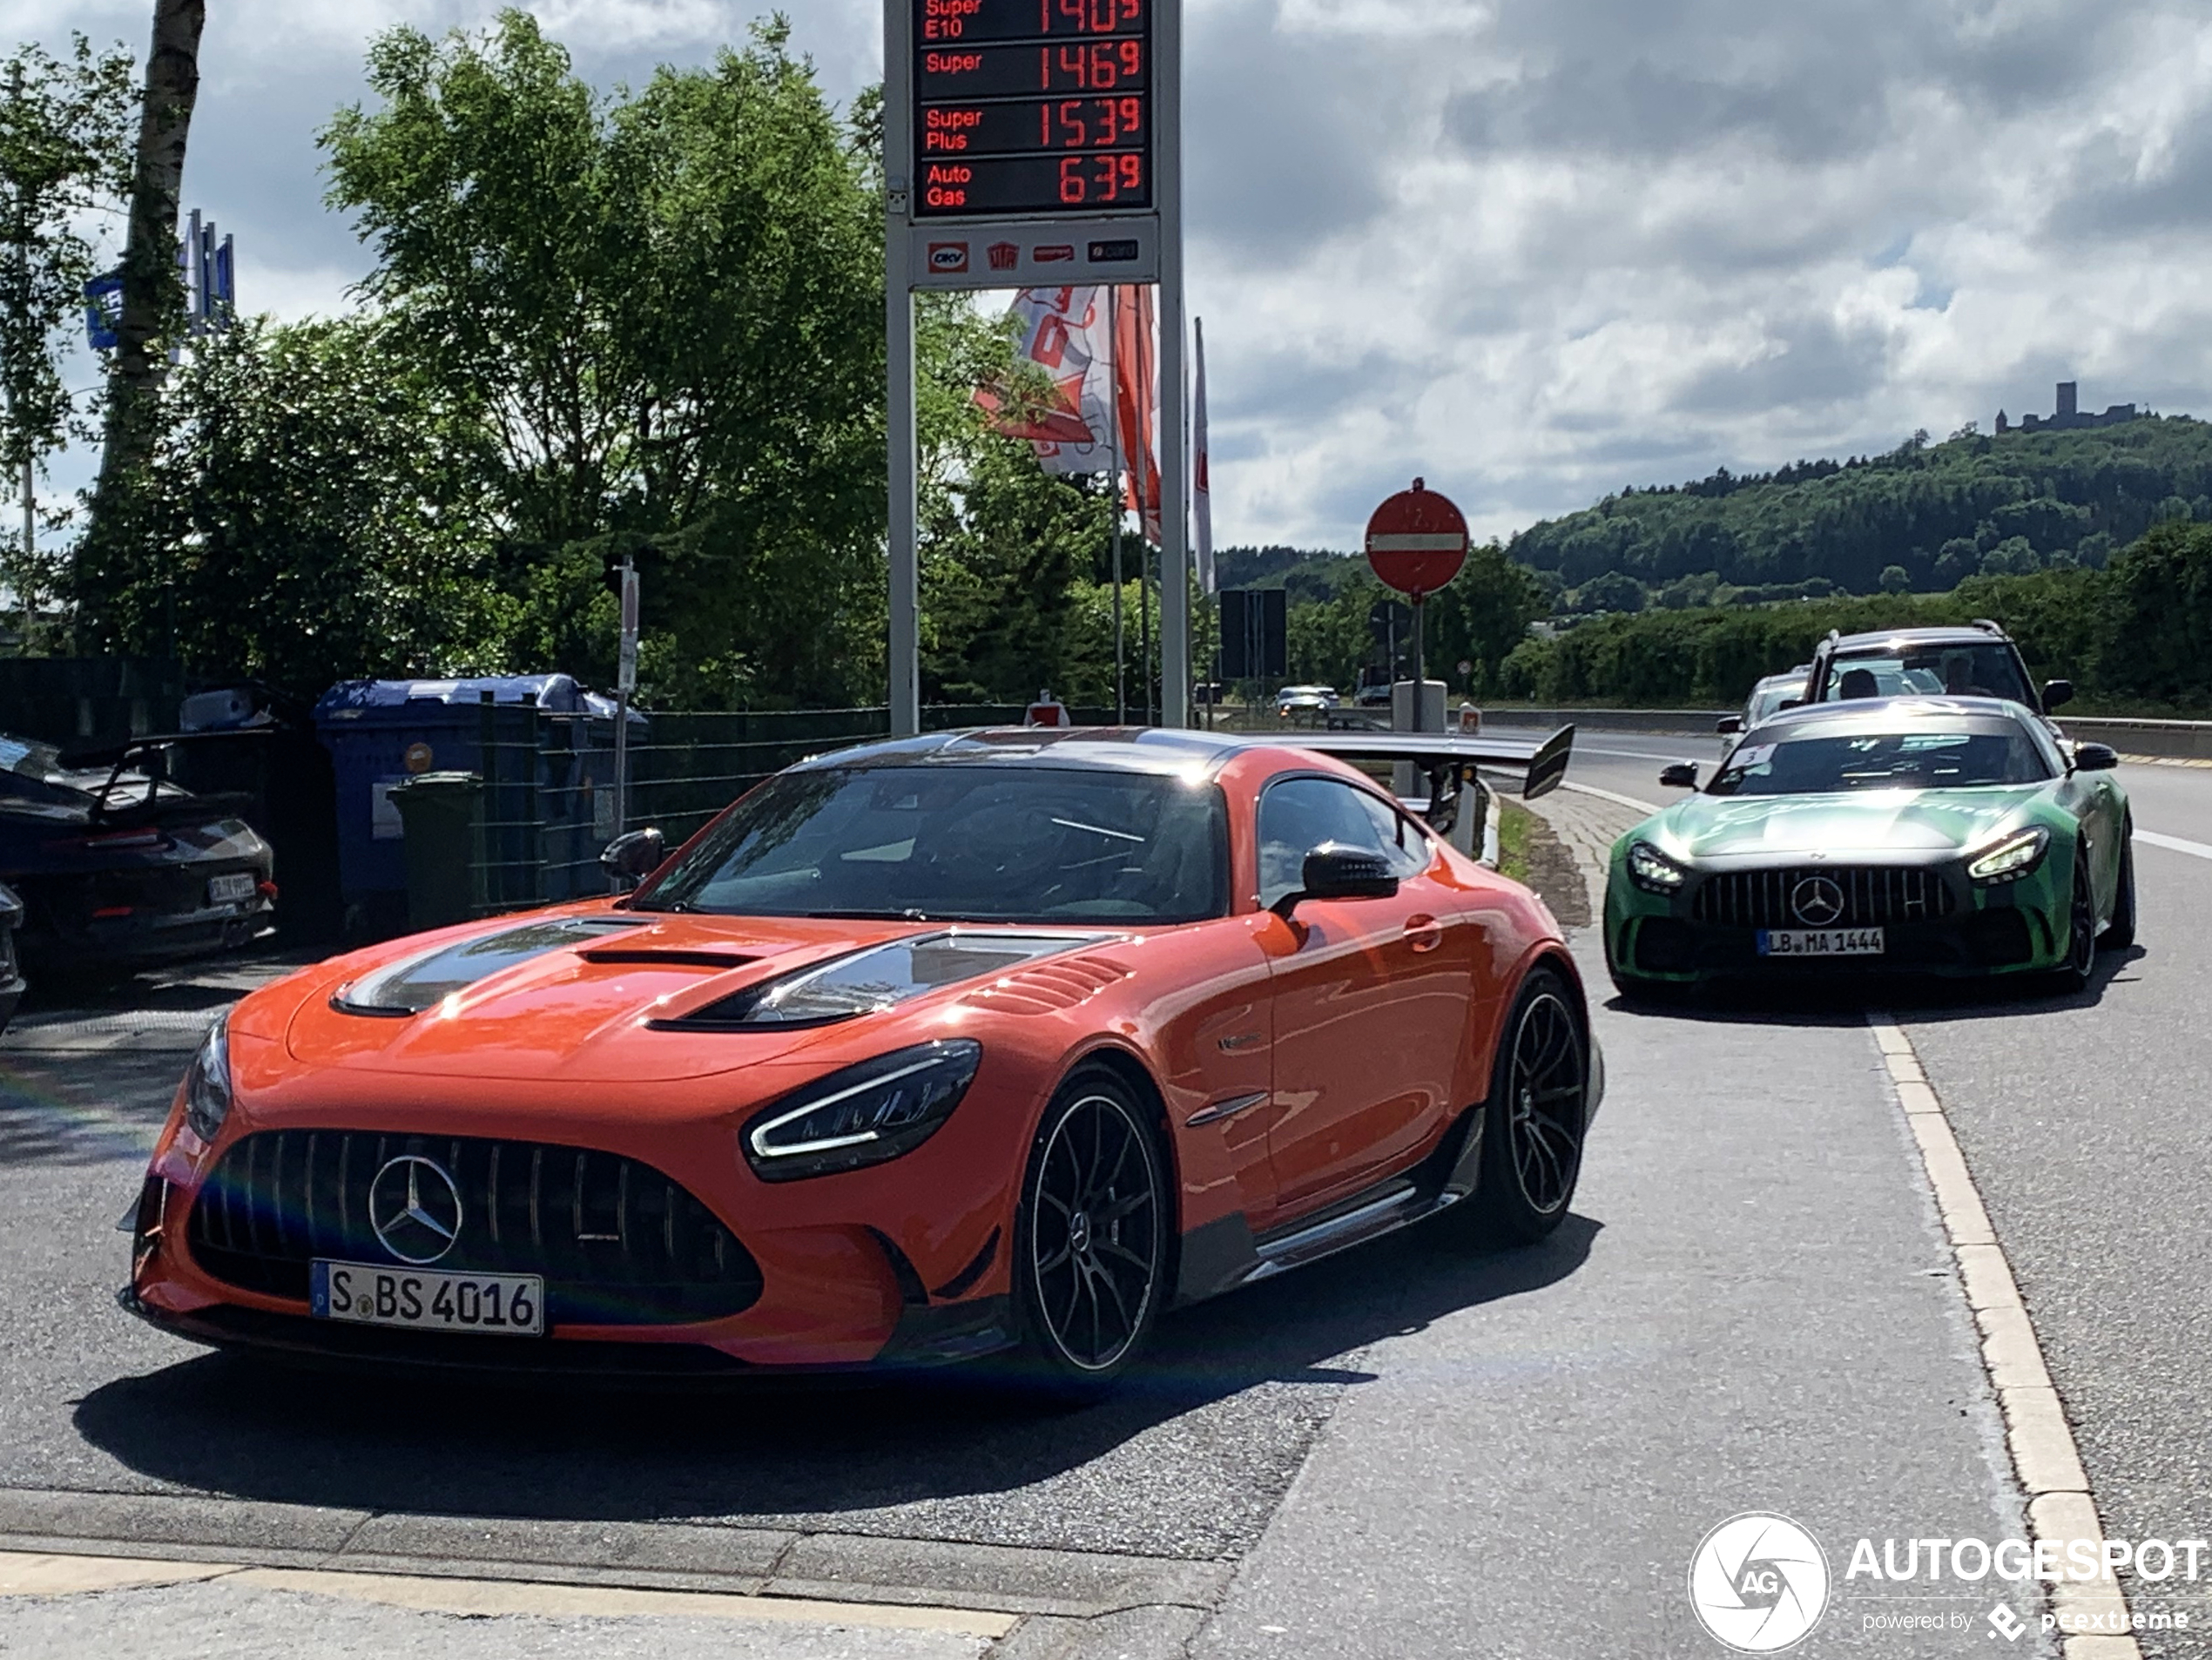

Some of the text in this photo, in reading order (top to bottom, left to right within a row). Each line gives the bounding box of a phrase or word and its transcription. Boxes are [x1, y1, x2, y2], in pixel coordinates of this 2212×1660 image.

[927, 0, 982, 17] Super
[925, 19, 962, 39] E10
[927, 53, 982, 74] Super
[1042, 40, 1140, 89] 1469
[927, 110, 983, 131] Super
[1042, 98, 1140, 146] 1539
[927, 132, 968, 150] Plus
[927, 165, 973, 184] Auto
[1060, 154, 1140, 203] 639
[927, 187, 966, 206] Gas
[1769, 930, 1881, 953] LB MA 1444
[332, 1271, 352, 1312] S
[376, 1275, 422, 1320] BS
[432, 1280, 534, 1327] 4016
